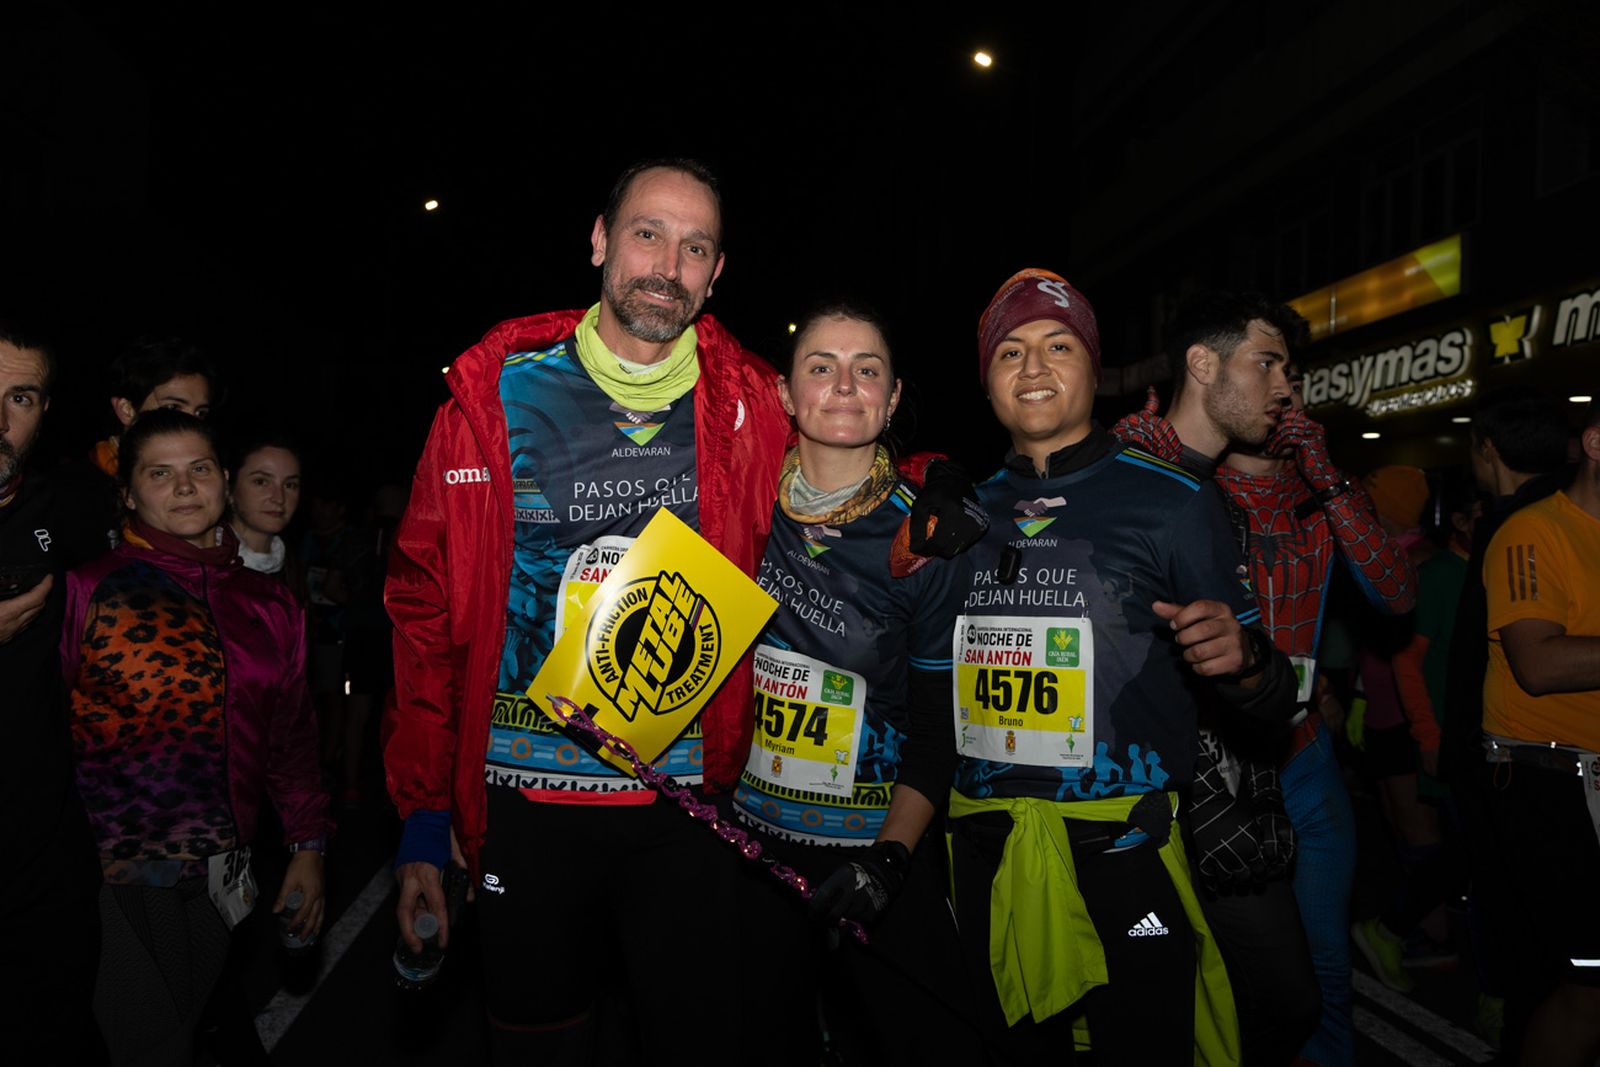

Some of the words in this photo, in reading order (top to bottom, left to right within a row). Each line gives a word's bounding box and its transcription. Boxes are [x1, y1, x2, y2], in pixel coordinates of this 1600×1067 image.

[612, 446, 671, 458] ALDEVARAN
[574, 479, 646, 499] PASOS
[569, 502, 632, 522] DEJAN
[1036, 567, 1078, 586] QUE
[808, 588, 844, 615] QUE
[969, 589, 1015, 608] DEJAN
[1019, 589, 1086, 608] HUELLA
[790, 597, 846, 638] HUELLA
[596, 587, 648, 684] ANTI-FRICTION
[666, 623, 715, 704] TREATMENT
[614, 573, 682, 720] METAL
[977, 632, 1014, 646] NOCHE
[1015, 633, 1033, 647] DE
[964, 649, 985, 663] SAN
[986, 647, 1032, 666] ANTÓN
[755, 657, 790, 680] NOCHE
[792, 668, 811, 682] DE
[763, 677, 808, 700] ANTÓN
[975, 668, 1058, 715] 4576
[998, 715, 1024, 727] Bruno
[764, 739, 795, 755] Myriam
[1128, 926, 1169, 937] adidas
